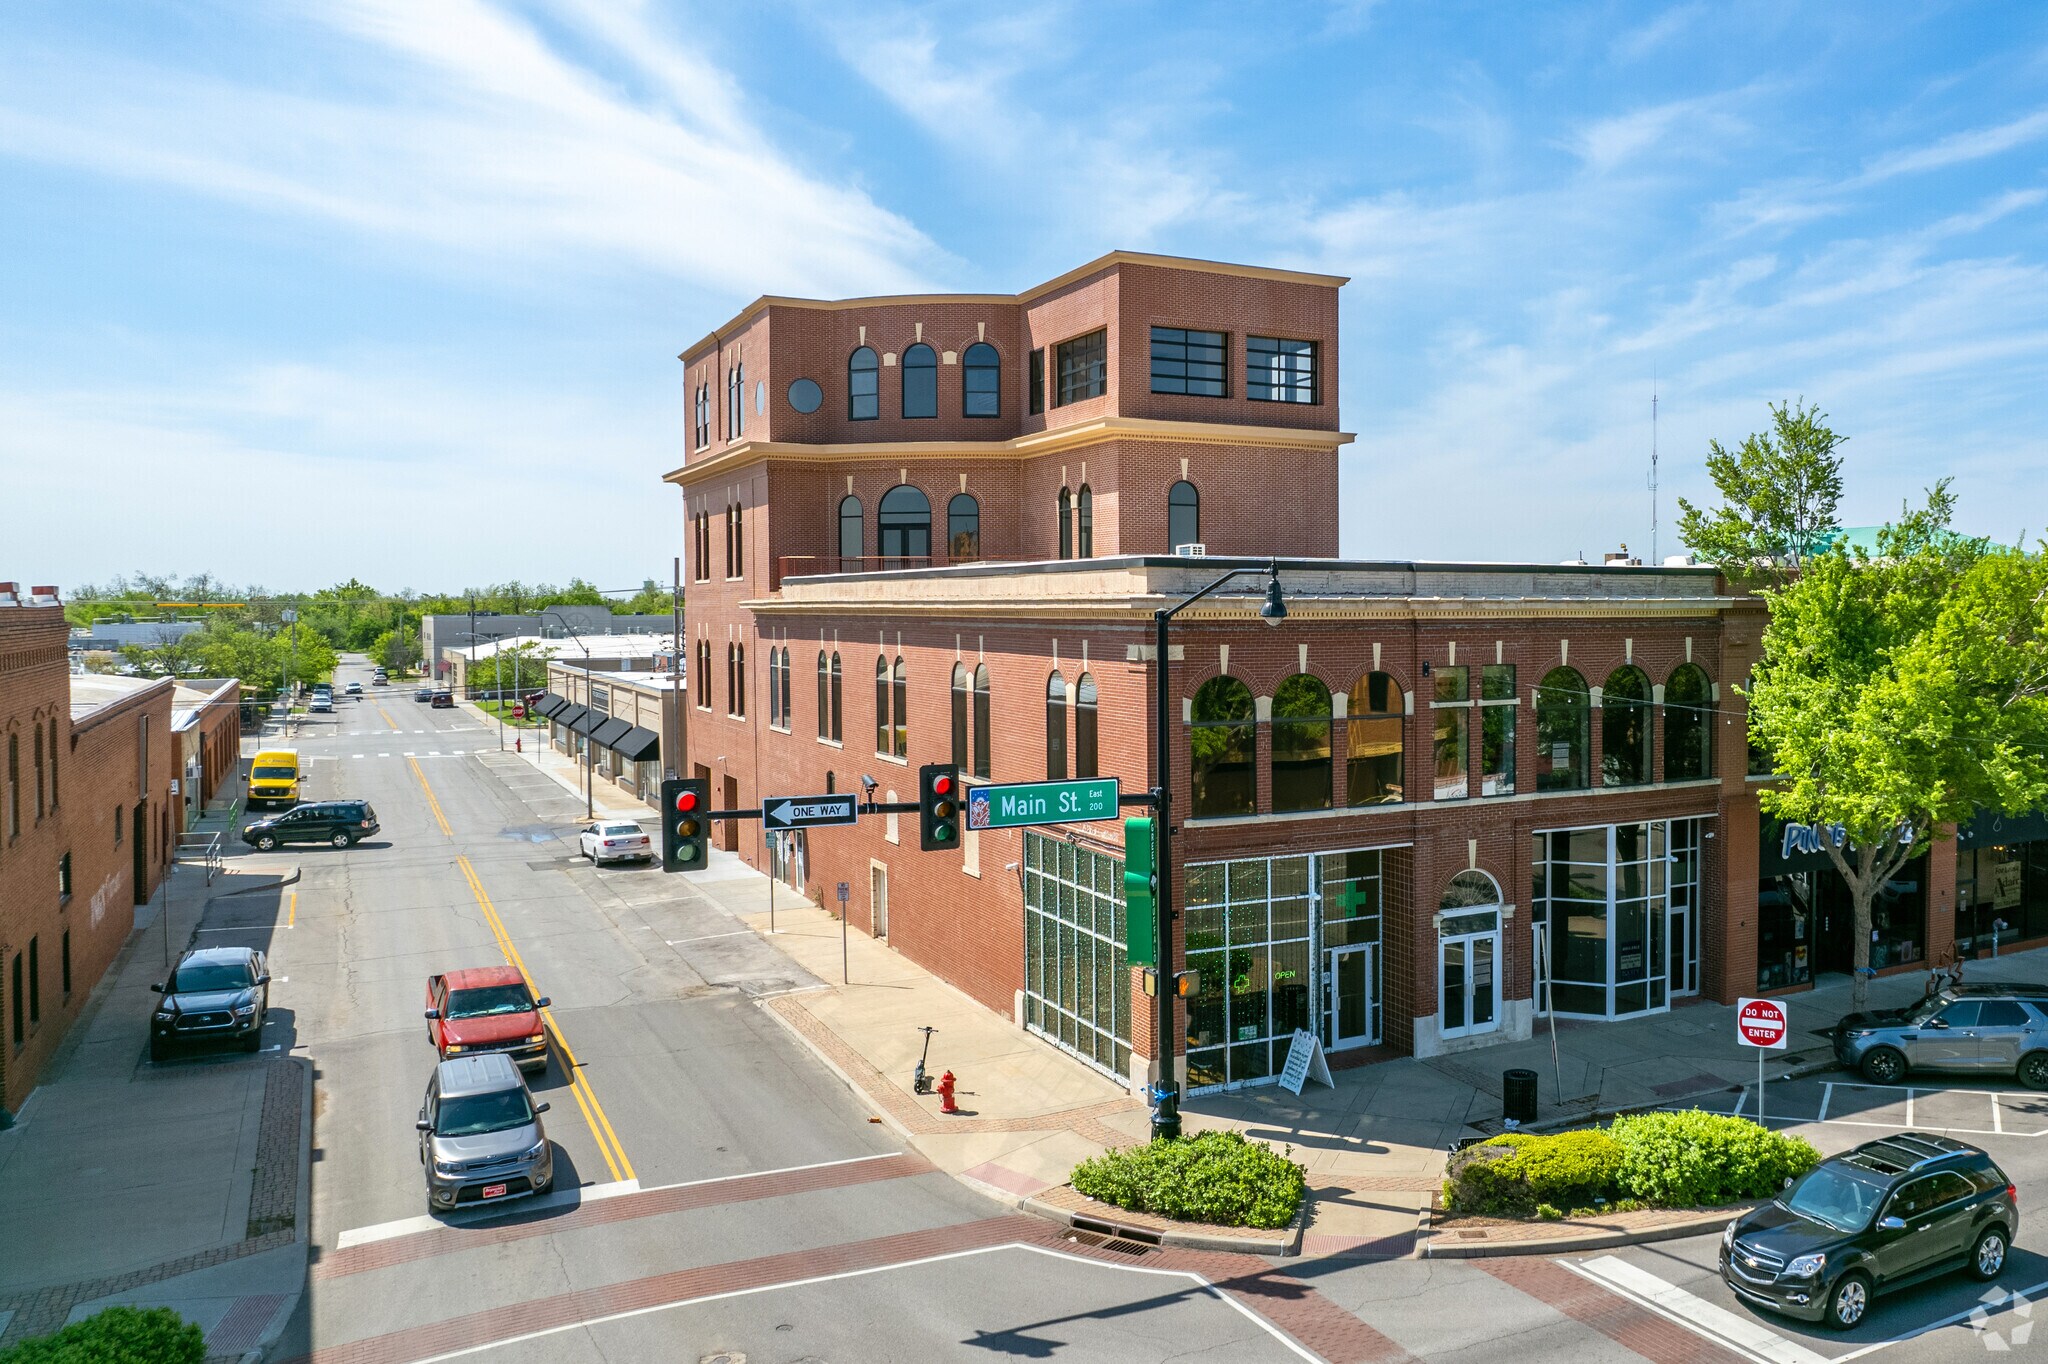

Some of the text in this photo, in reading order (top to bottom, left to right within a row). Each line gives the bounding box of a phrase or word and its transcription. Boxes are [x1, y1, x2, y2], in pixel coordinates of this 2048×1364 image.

[1089, 789, 1103, 798] East
[1001, 791, 1081, 817] Main St.
[1089, 802, 1103, 811] 200
[793, 805, 842, 817] ONE WAY
[1274, 970, 1296, 980] OPEN
[1745, 1008, 1779, 1018] DO NOT
[1748, 1028, 1775, 1039] ENTER
